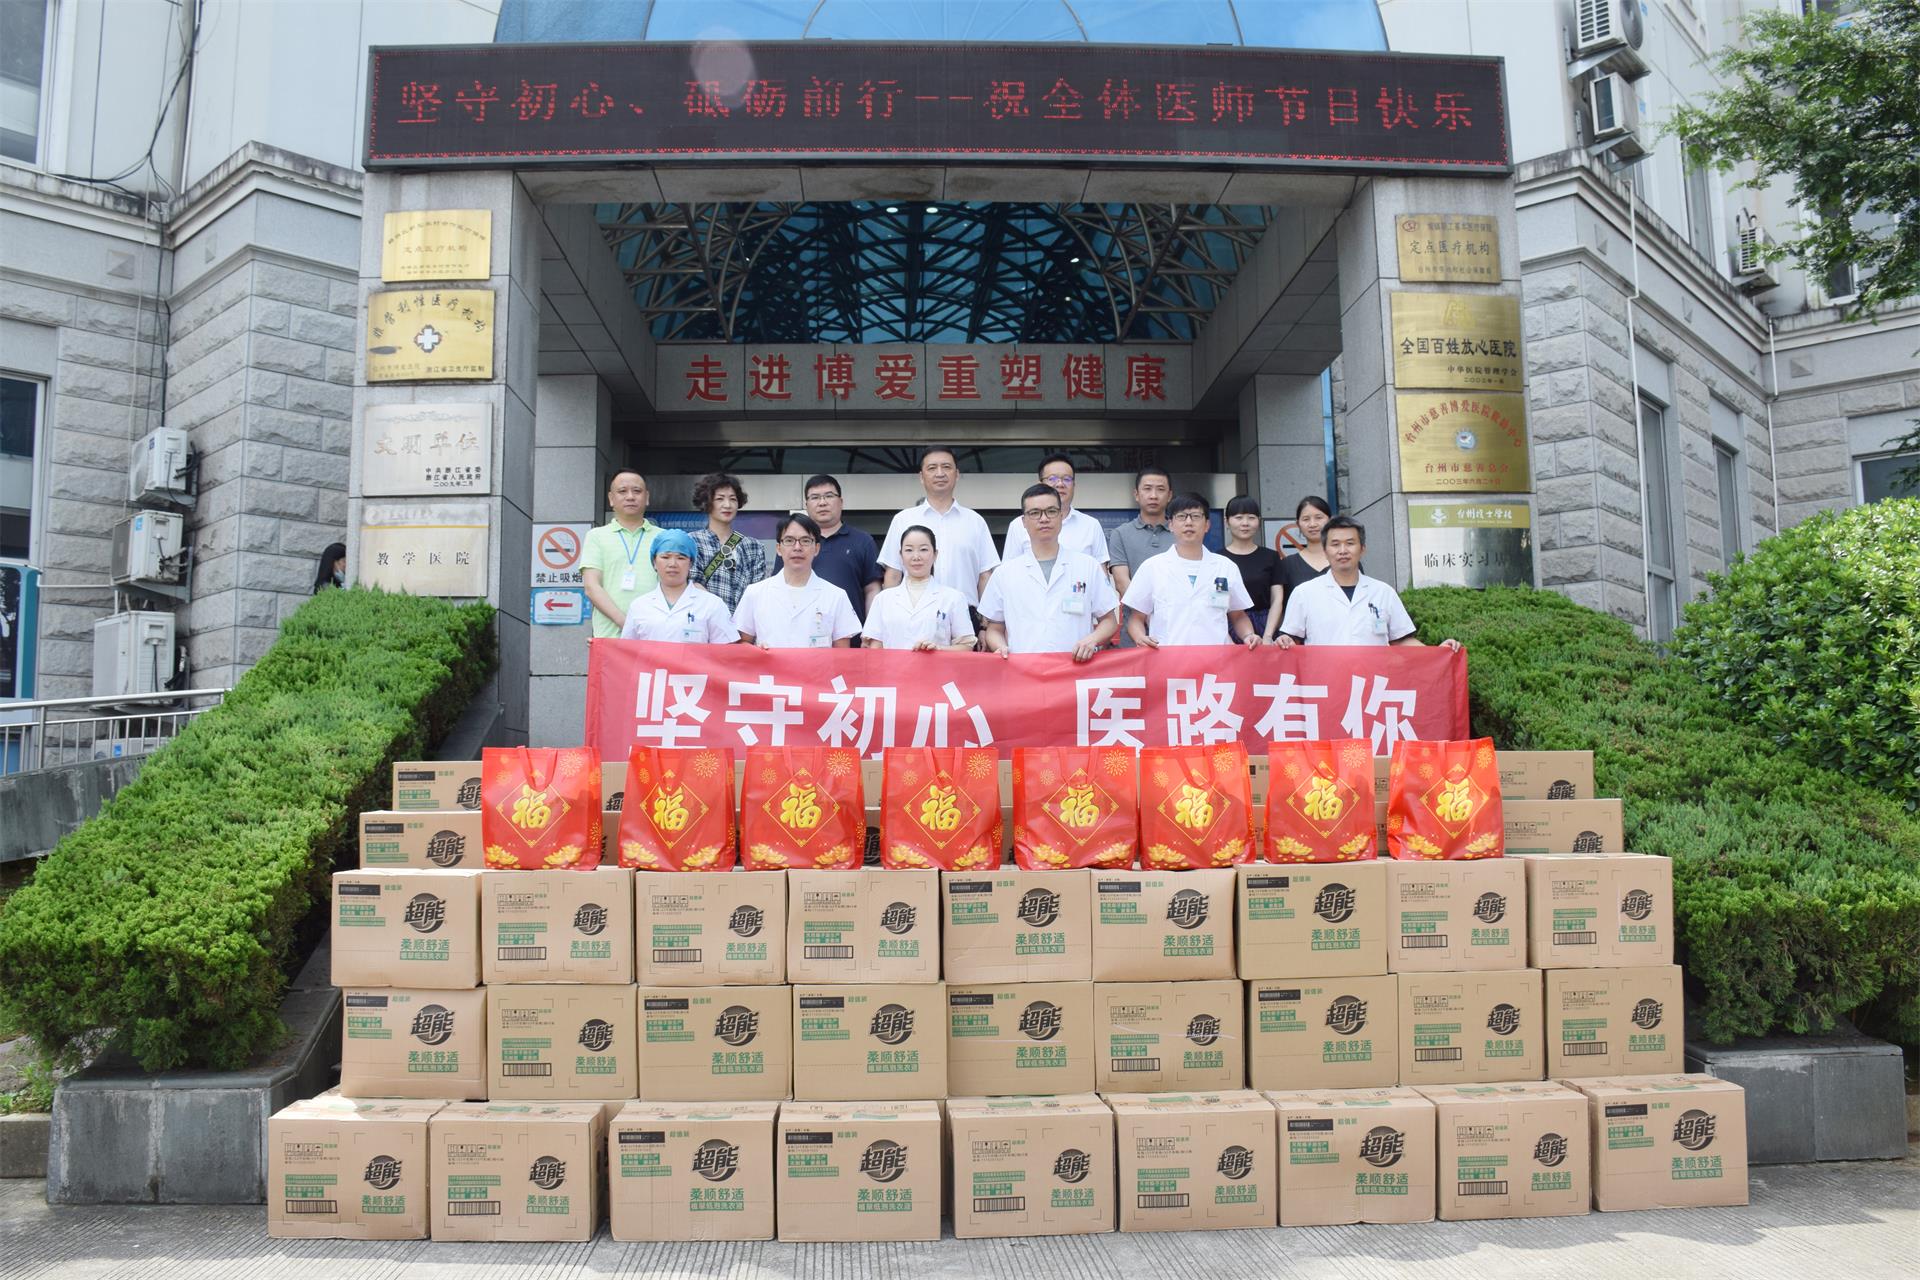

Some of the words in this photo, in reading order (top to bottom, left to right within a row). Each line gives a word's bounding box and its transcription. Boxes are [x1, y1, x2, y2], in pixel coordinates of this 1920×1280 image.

[1409, 240, 1490, 256] 定点医疗机构
[1400, 336, 1517, 358] 全国百姓放心医院
[685, 352, 1167, 402] 走进博爱重塑健康
[376, 551, 470, 566] 教学医院
[535, 572, 583, 584] 禁止吸烟
[634, 668, 994, 759] 坚守初心
[1075, 674, 1419, 757] 医路有你
[512, 784, 551, 829] 福
[653, 786, 691, 831] 福
[779, 782, 823, 829] 福
[920, 785, 962, 832] 福
[1060, 784, 1101, 828] 福
[1173, 784, 1214, 829] 福
[1303, 776, 1344, 820] 福
[1435, 778, 1474, 822] 福
[426, 836, 466, 860] 超能
[403, 896, 446, 924] 超能
[1017, 893, 1061, 921] 超能
[1166, 894, 1210, 923] 超能
[1313, 888, 1357, 917] 超能
[1473, 895, 1507, 919] 超能
[1620, 893, 1653, 915] 超能
[573, 907, 608, 929] 超能
[728, 907, 765, 931] 超能
[880, 904, 917, 929] 超能
[400, 938, 450, 951] 柔顺舒适
[1015, 932, 1065, 945] 柔顺舒适
[1164, 935, 1213, 947] 柔顺舒适
[1311, 928, 1360, 940] 柔顺舒适
[410, 1010, 455, 1038] 超能
[714, 1011, 759, 1038] 超能
[869, 1009, 915, 1037] 超能
[1018, 1006, 1063, 1033] 超能
[1324, 1000, 1369, 1029] 超能
[1486, 1006, 1521, 1030] 超能
[1630, 1002, 1664, 1024] 超能
[578, 1022, 614, 1046] 超能
[1185, 1018, 1221, 1041] 超能
[408, 1050, 459, 1063] 柔顺舒适
[712, 1052, 763, 1064] 柔顺舒适
[867, 1050, 919, 1063] 柔顺舒适
[1016, 1045, 1068, 1058] 柔顺舒适
[1322, 1039, 1373, 1052] 柔顺舒适
[1672, 1115, 1718, 1148] 超能
[692, 1144, 740, 1173] 超能
[859, 1144, 908, 1173] 超能
[1358, 1130, 1406, 1162] 超能
[1533, 1138, 1570, 1163] 超能
[364, 1158, 404, 1184] 超能
[528, 1159, 568, 1184] 超能
[1053, 1153, 1092, 1178] 超能
[1216, 1149, 1255, 1174] 超能
[1671, 1156, 1723, 1169] 柔顺舒适
[1355, 1172, 1409, 1185] 柔顺舒适
[690, 1187, 745, 1201] 柔顺舒适
[857, 1188, 913, 1201] 柔顺舒适
